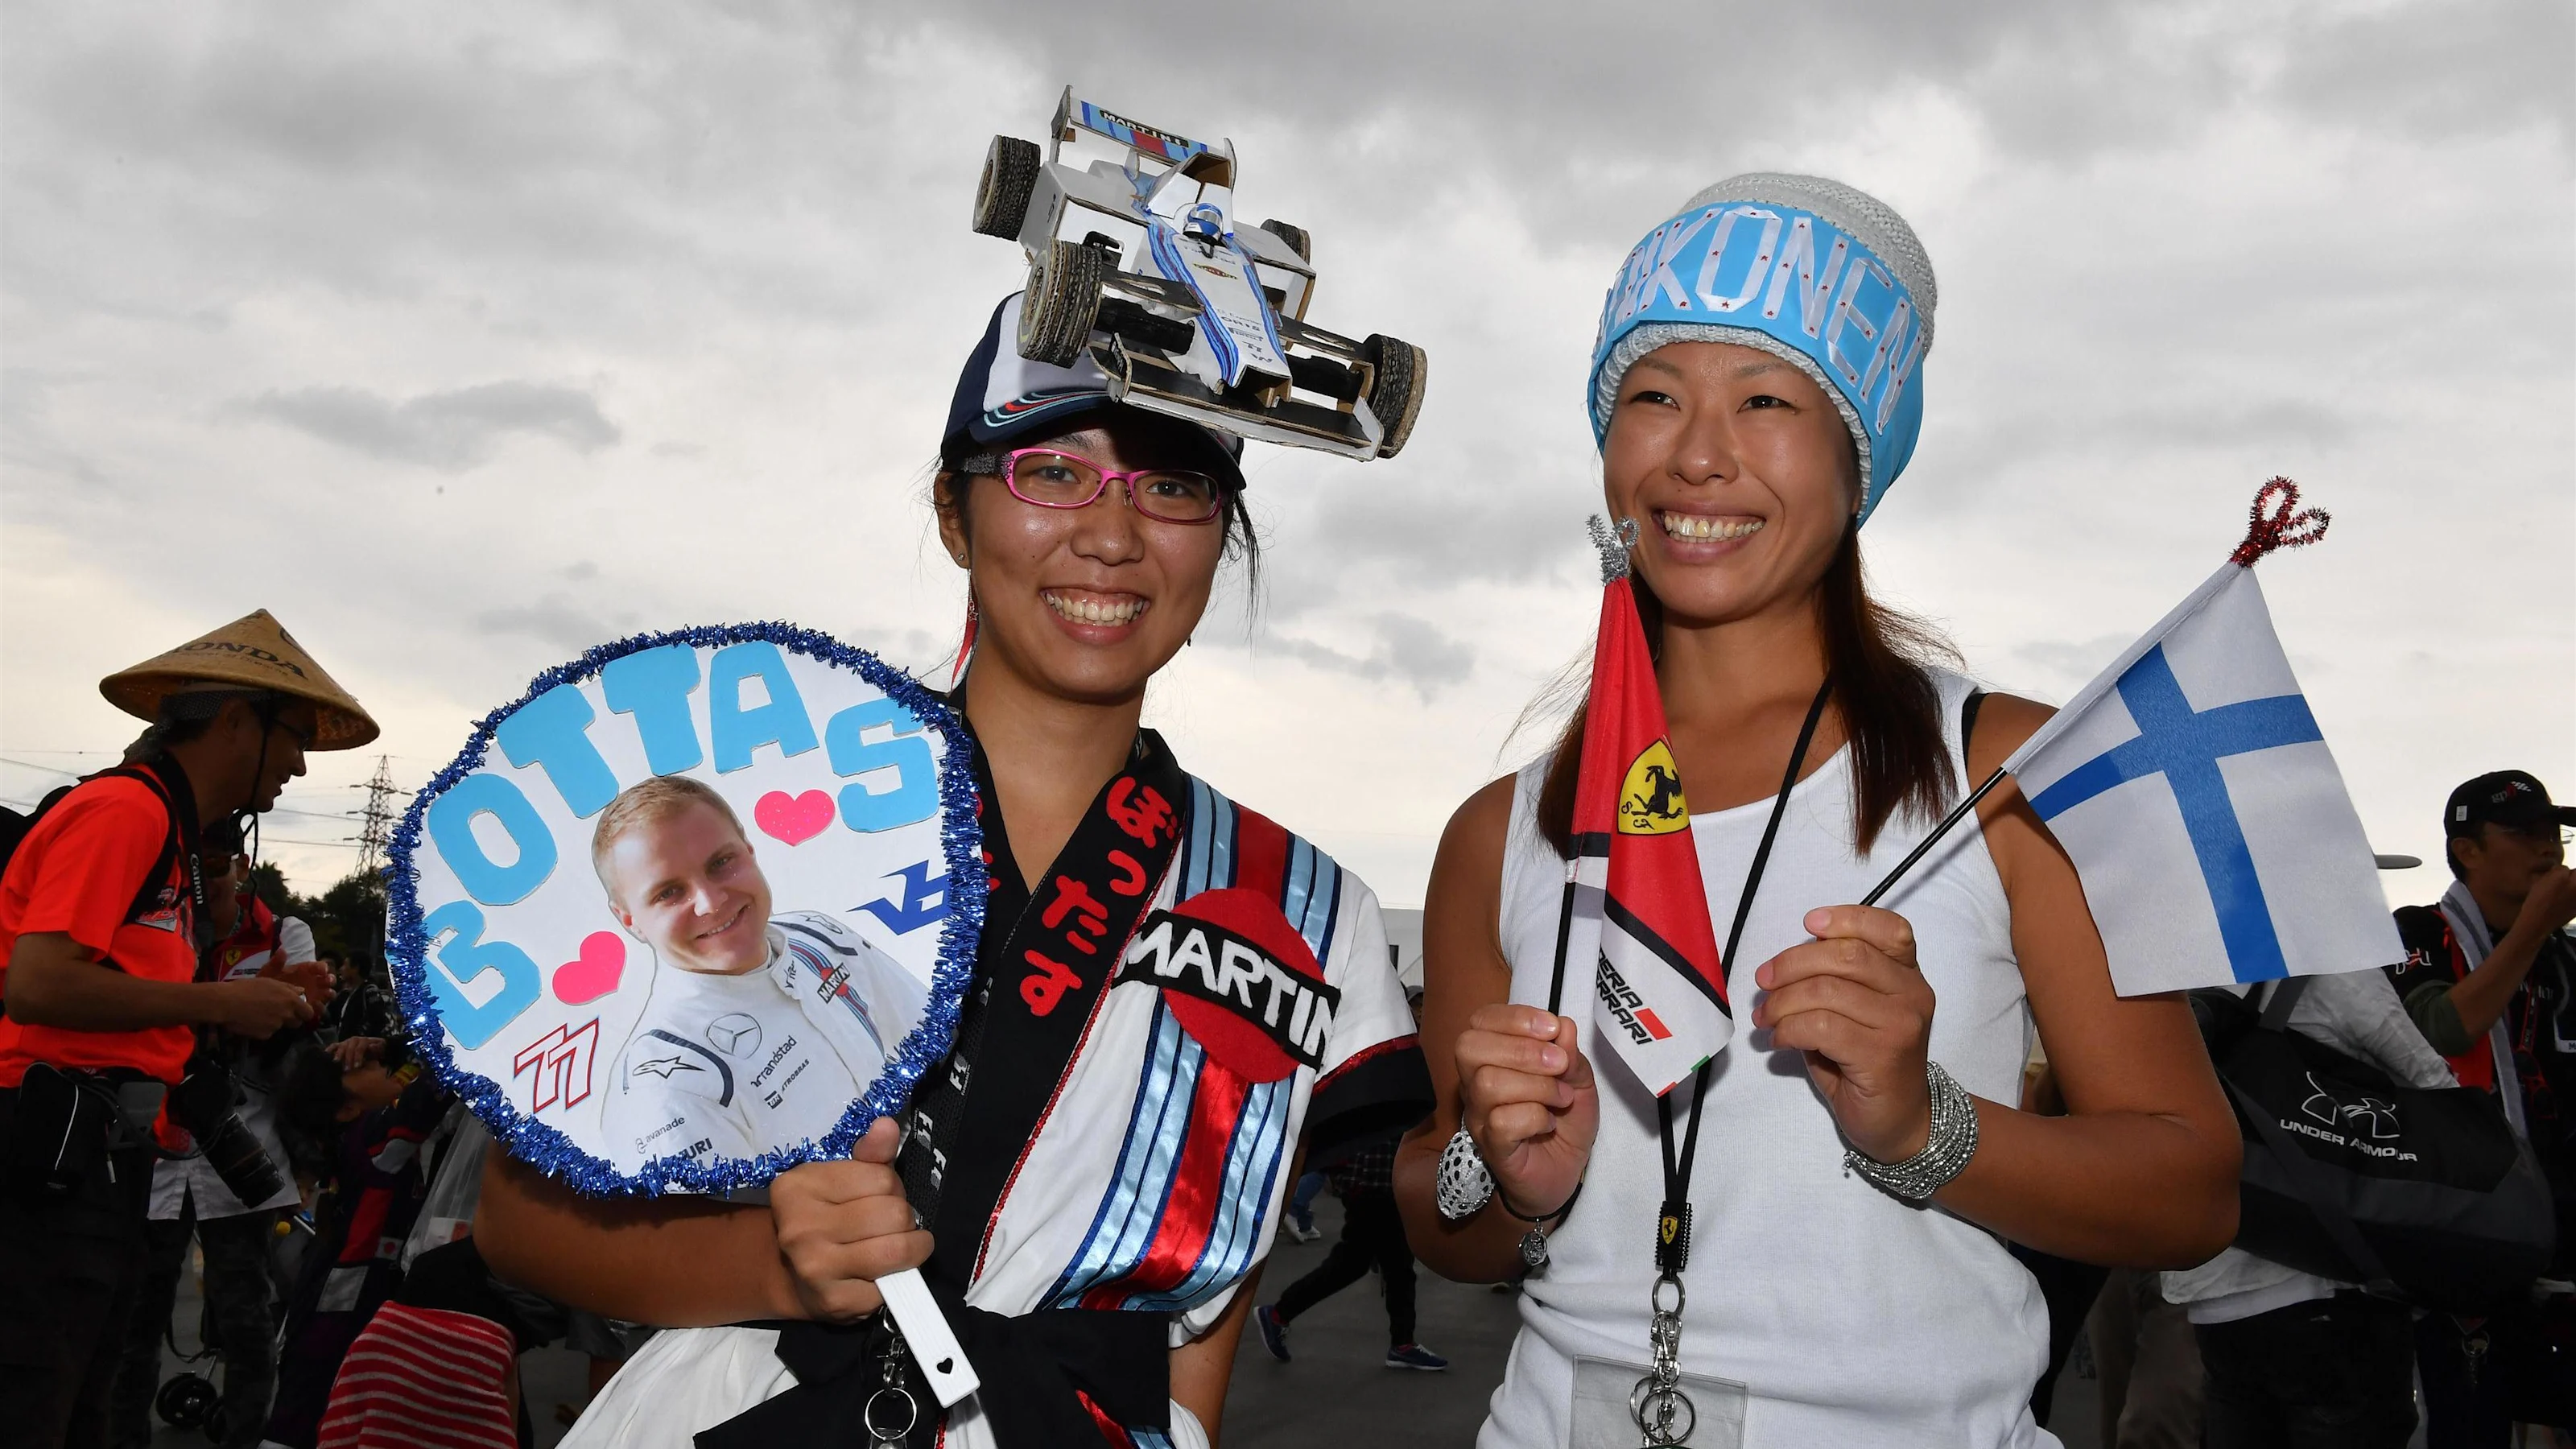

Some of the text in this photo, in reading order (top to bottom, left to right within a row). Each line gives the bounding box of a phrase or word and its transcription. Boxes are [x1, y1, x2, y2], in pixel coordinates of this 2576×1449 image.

[419, 639, 940, 1051] BOTTAS
[189, 852, 204, 906] Canon
[514, 1015, 601, 1114] 77
[646, 1117, 686, 1144] avanade
[2280, 1118, 2418, 1162] UNDER ARMOUR
